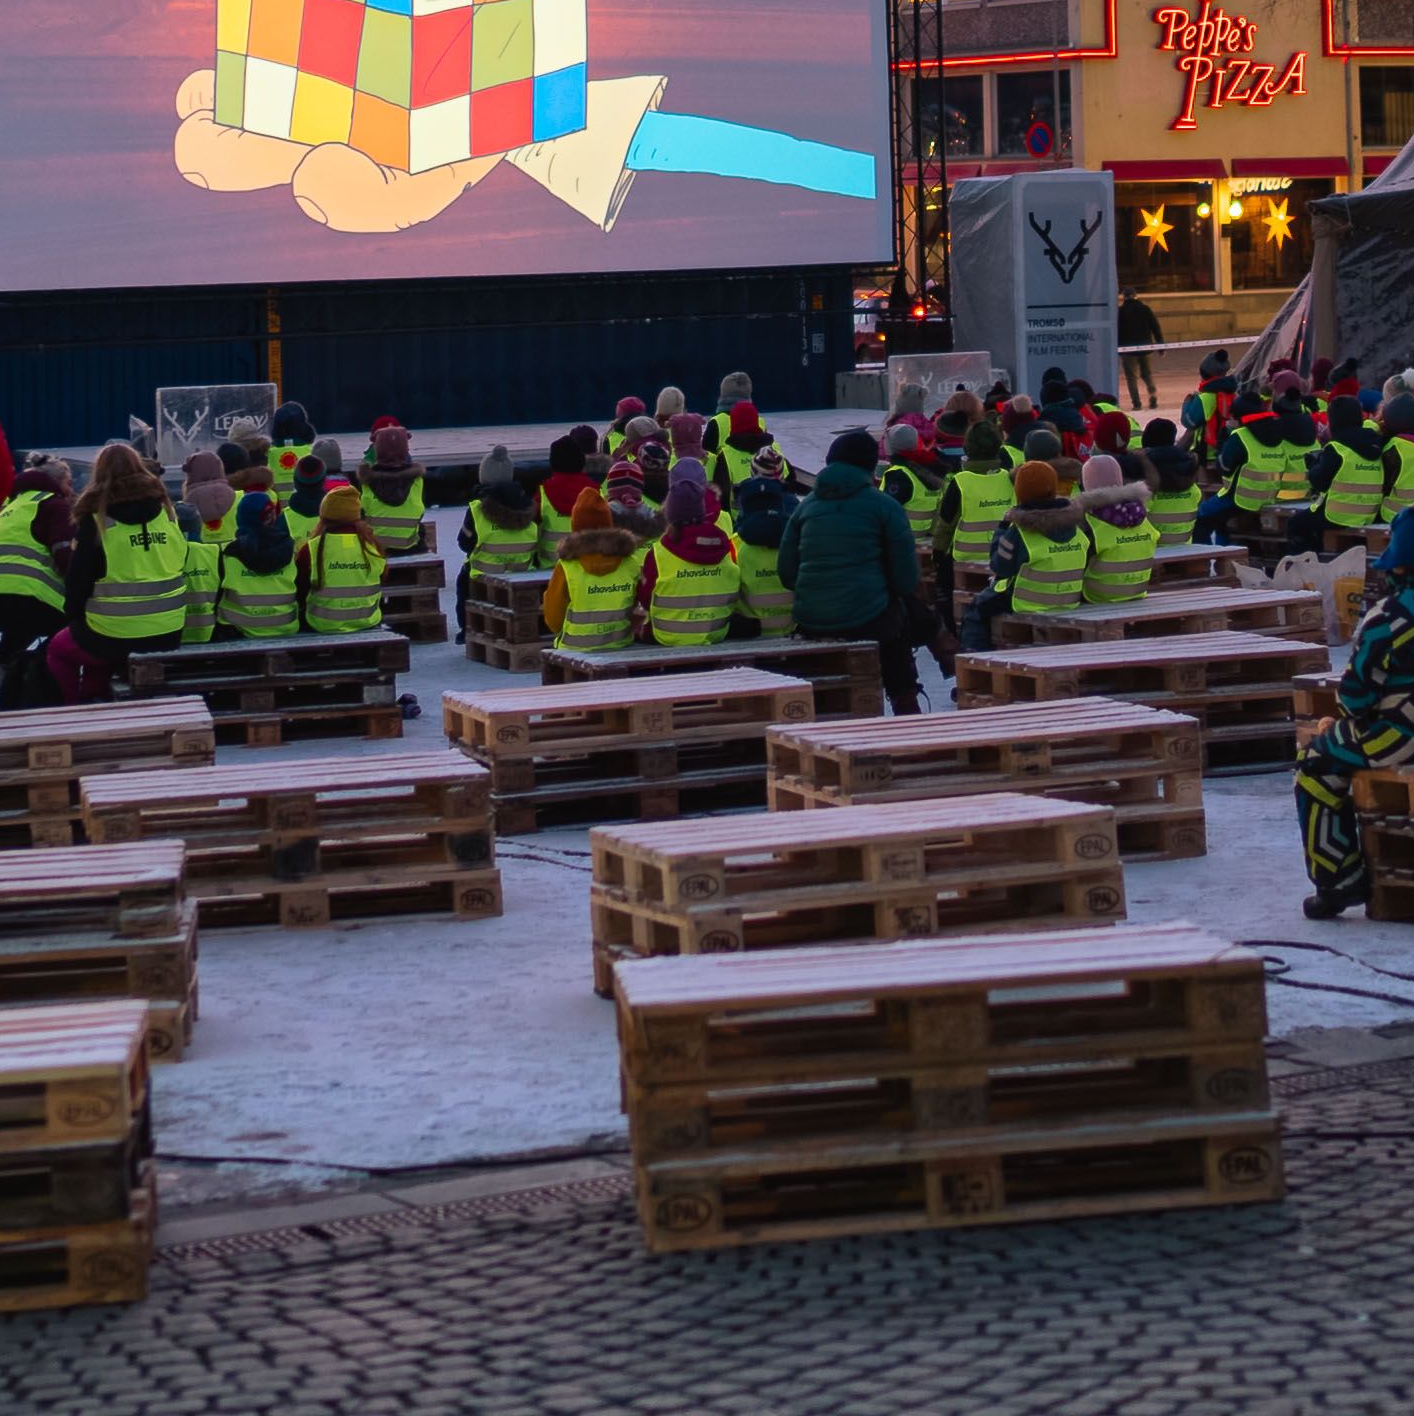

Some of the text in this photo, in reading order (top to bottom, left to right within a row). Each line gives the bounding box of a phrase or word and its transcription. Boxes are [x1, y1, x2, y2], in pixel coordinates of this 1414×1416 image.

[1154, 6, 1259, 58] Peppe's
[1179, 53, 1307, 129] PIZZA
[1027, 318, 1065, 328] TROMSØ
[1028, 332, 1095, 343] INTERNATIONAL
[1028, 345, 1089, 356] FILM FESTIVAL
[677, 568, 722, 579] Ishavskraft
[588, 583, 632, 595] Ishavskraft
